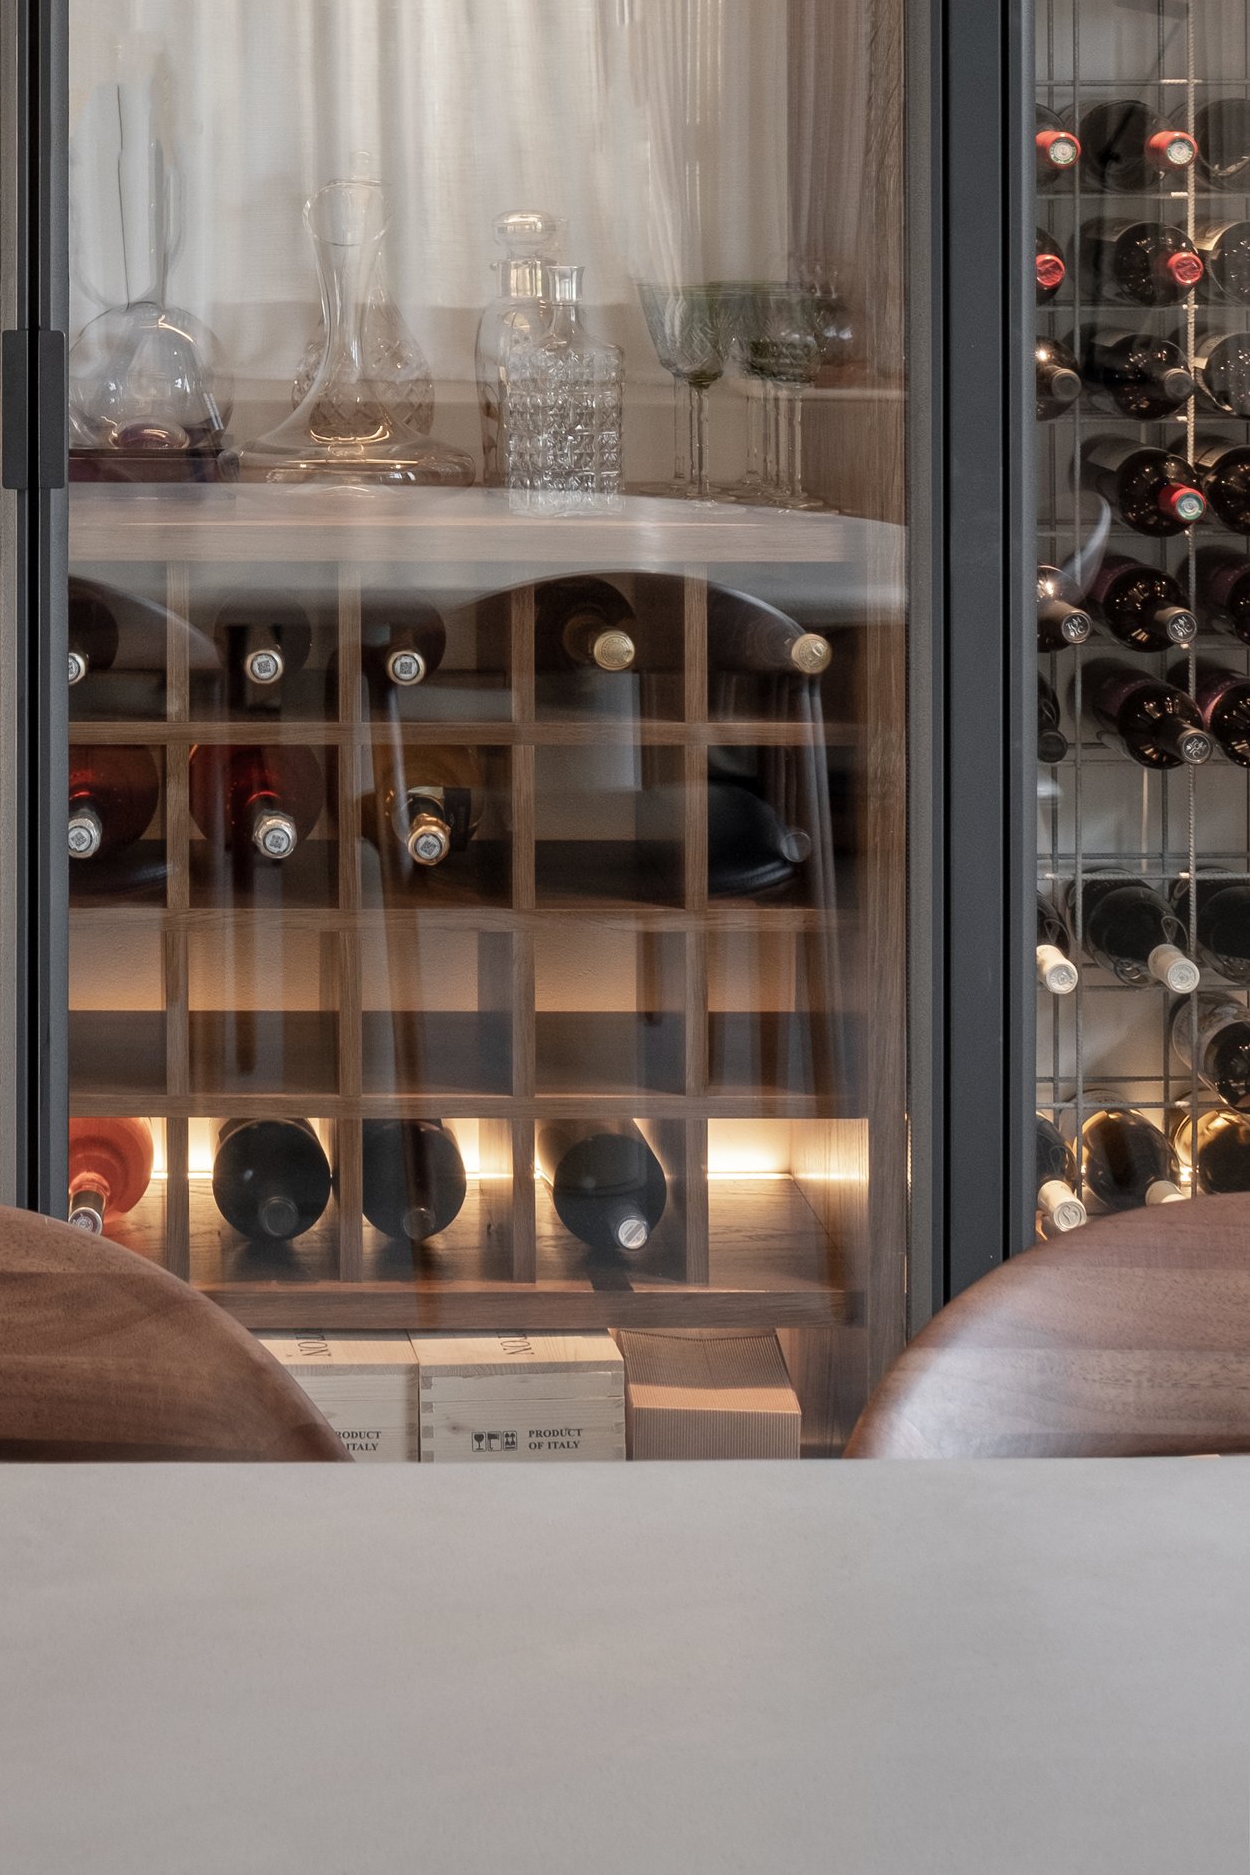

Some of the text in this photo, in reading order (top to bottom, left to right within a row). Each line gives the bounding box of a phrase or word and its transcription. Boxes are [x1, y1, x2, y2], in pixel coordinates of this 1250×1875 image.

[334, 1430, 382, 1441] RODUCT
[527, 1427, 583, 1439] PRODUCT
[527, 1440, 582, 1451] OF ITALY
